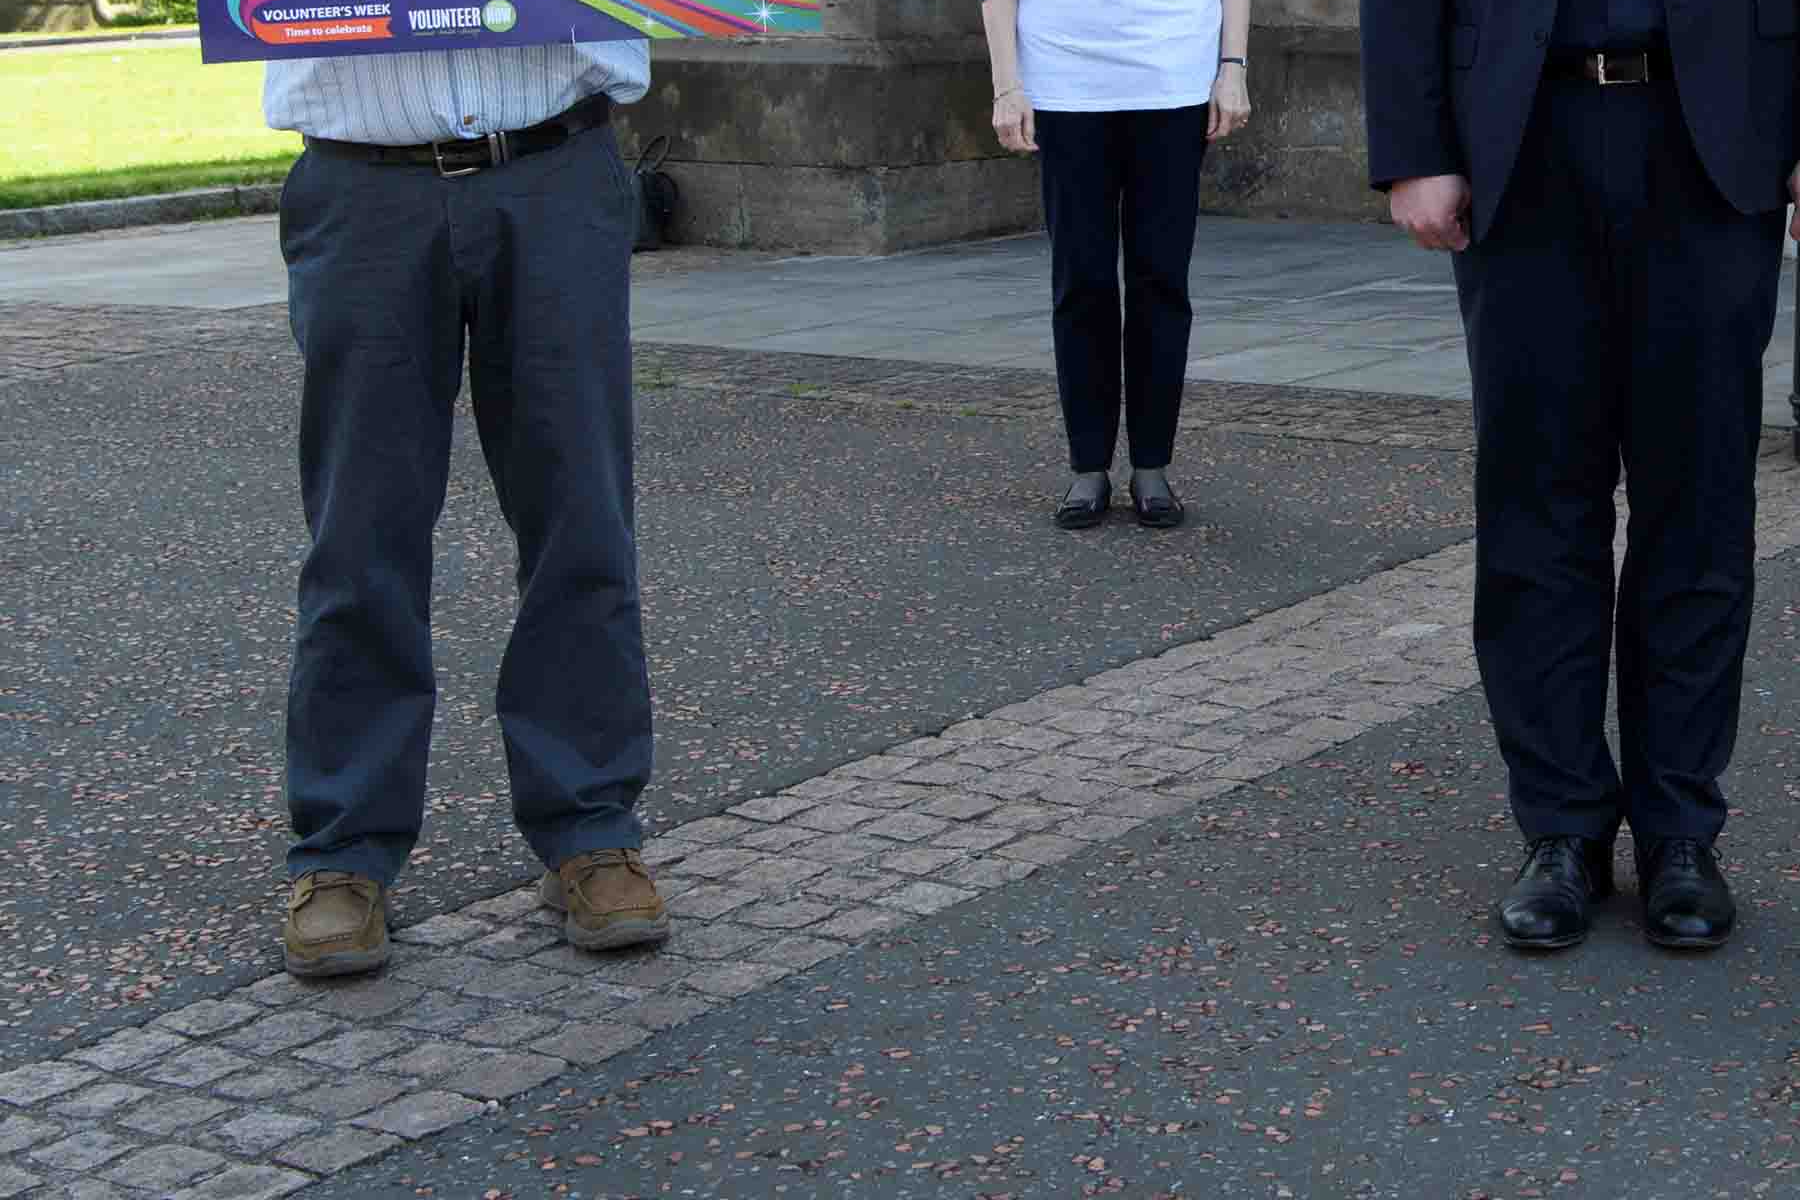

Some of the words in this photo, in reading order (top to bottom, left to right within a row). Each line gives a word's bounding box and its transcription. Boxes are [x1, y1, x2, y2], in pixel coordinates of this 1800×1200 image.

[263, 6, 352, 21] VOLUNTEER'S
[353, 3, 391, 16] WEEK
[408, 7, 481, 30] VOLUNTEER
[285, 27, 310, 37] Time
[312, 26, 322, 35] to
[324, 24, 372, 35] celebrate
